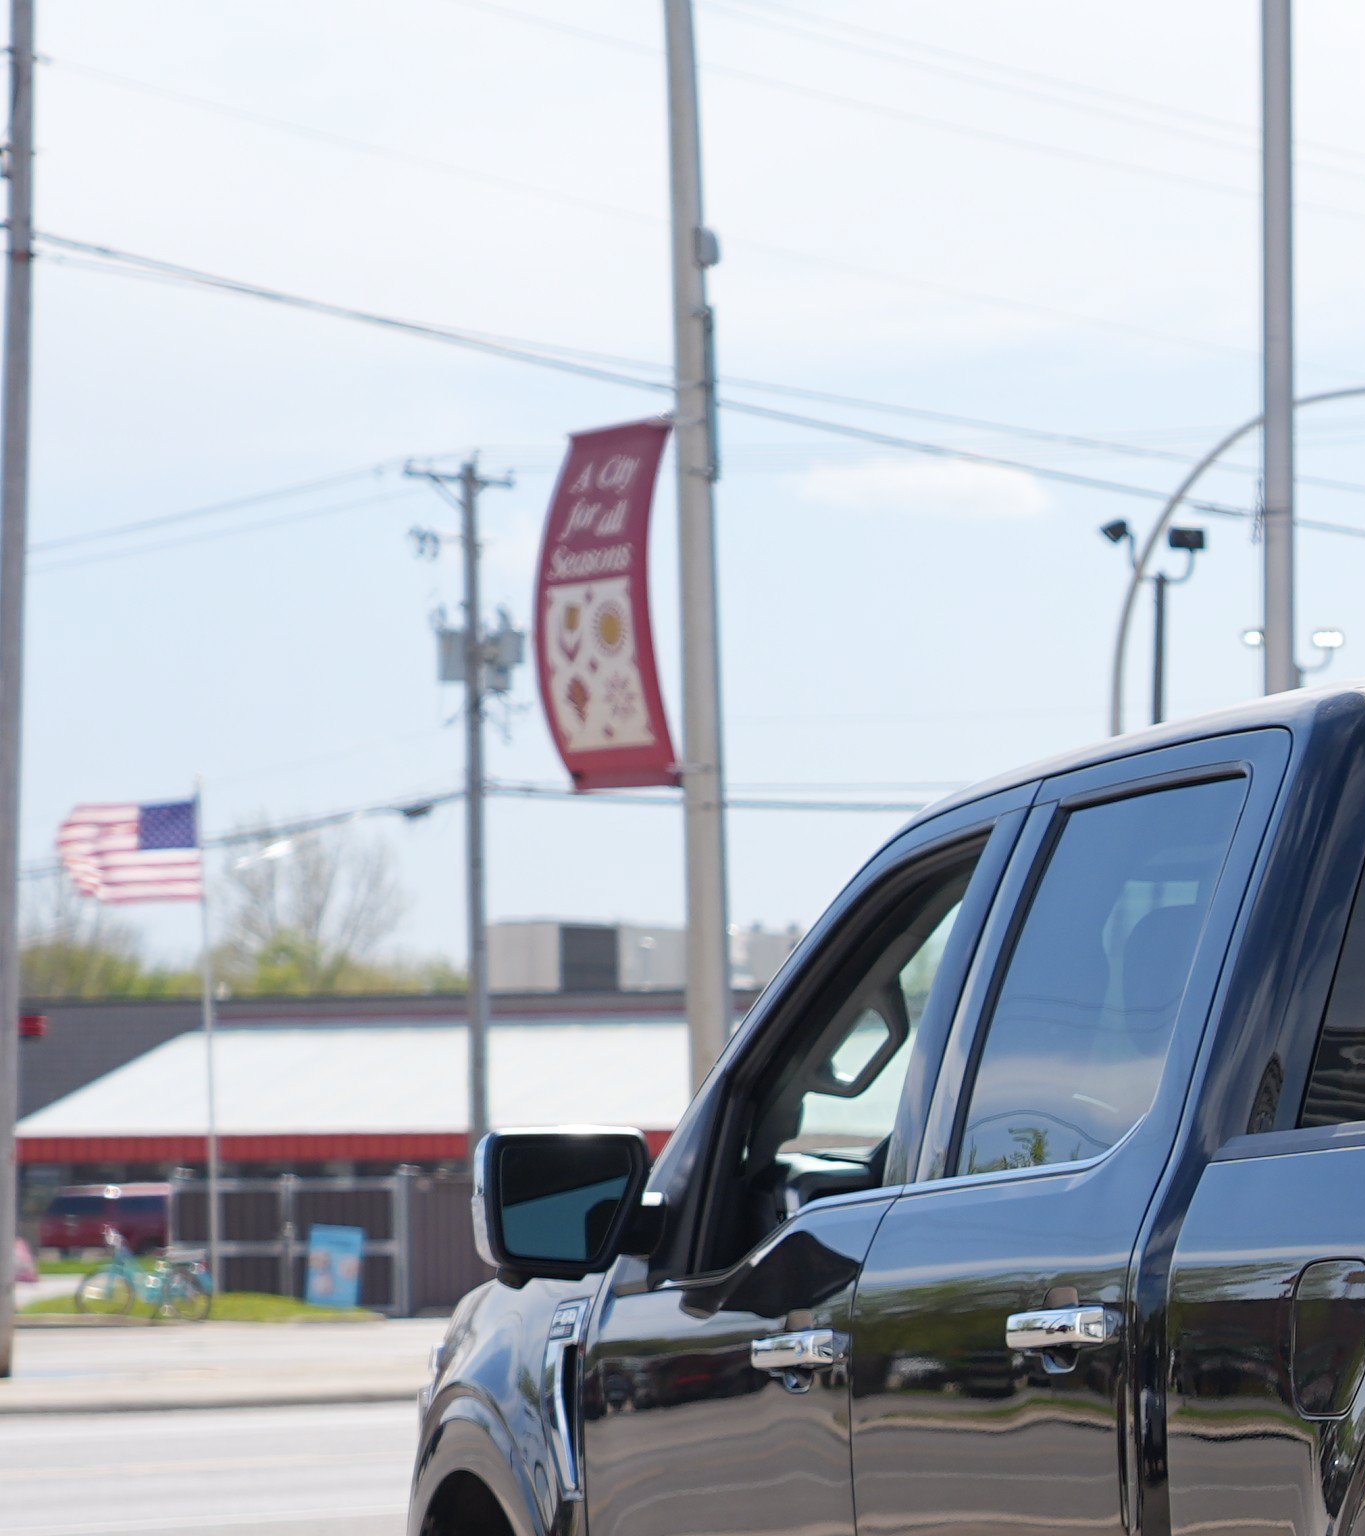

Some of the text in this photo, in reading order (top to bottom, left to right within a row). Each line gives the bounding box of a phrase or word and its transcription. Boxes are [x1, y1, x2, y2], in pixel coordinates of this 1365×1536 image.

[568, 454, 641, 494] A City
[557, 497, 628, 542] for all
[546, 542, 633, 579] Seasons
